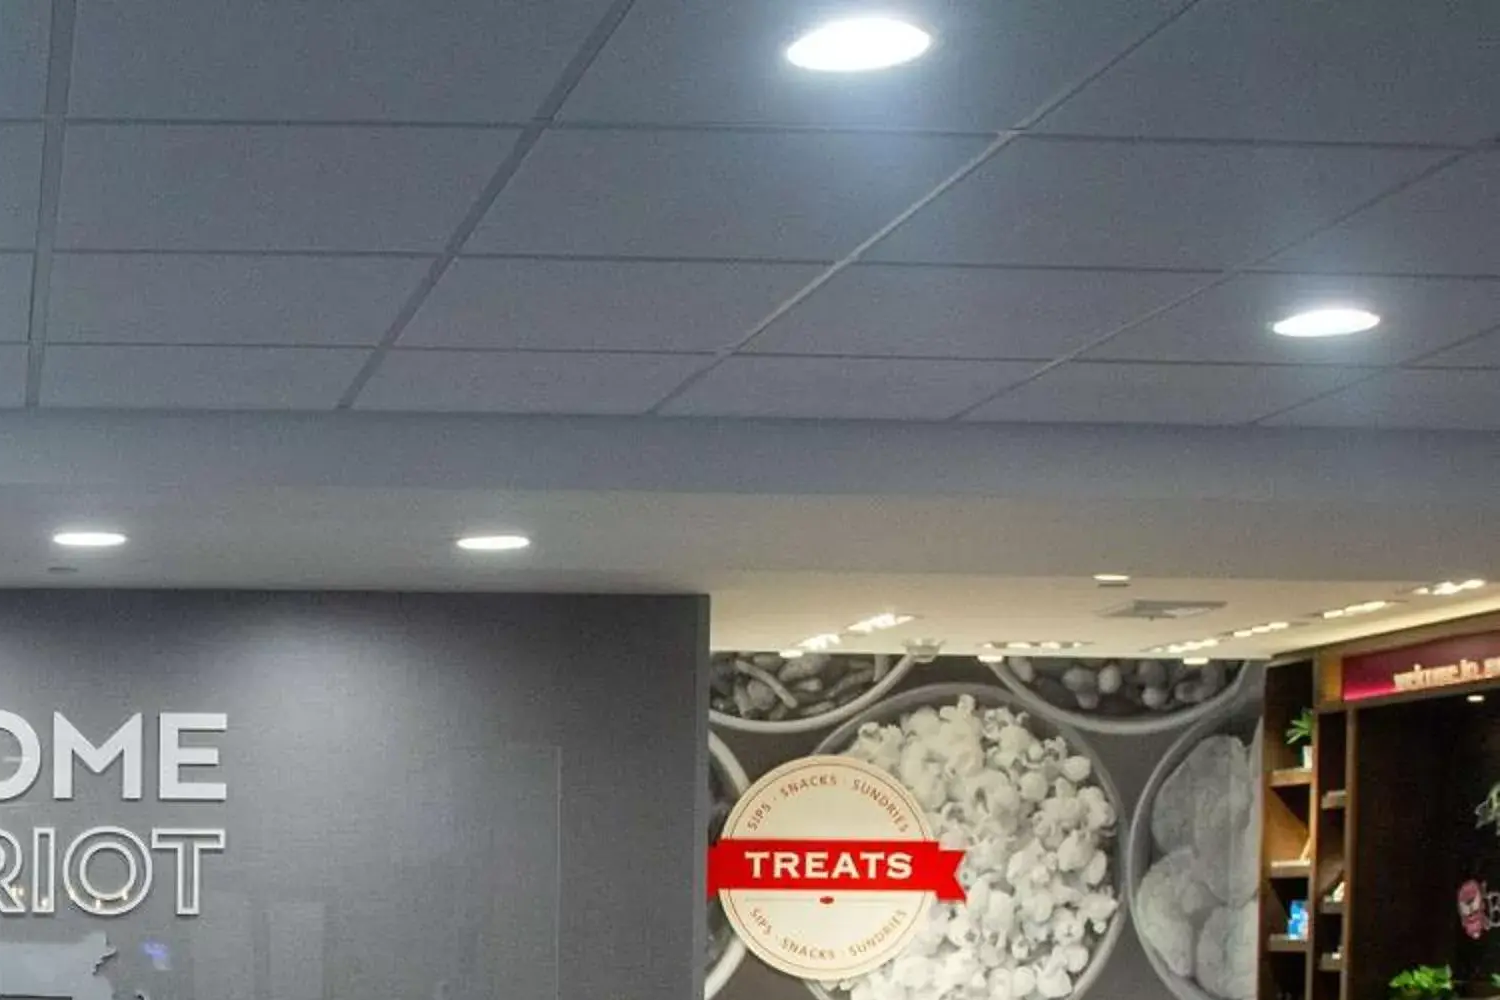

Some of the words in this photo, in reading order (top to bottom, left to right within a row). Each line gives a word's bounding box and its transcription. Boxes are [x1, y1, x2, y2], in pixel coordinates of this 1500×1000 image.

[747, 803, 772, 831] SIPS
[780, 775, 838, 797] SNACKS
[852, 779, 909, 833] SUNDRIES
[744, 851, 913, 880] TREATS
[749, 907, 773, 936] SIPS
[781, 938, 835, 960] SNACKS
[849, 909, 907, 957] SUNDRIES
